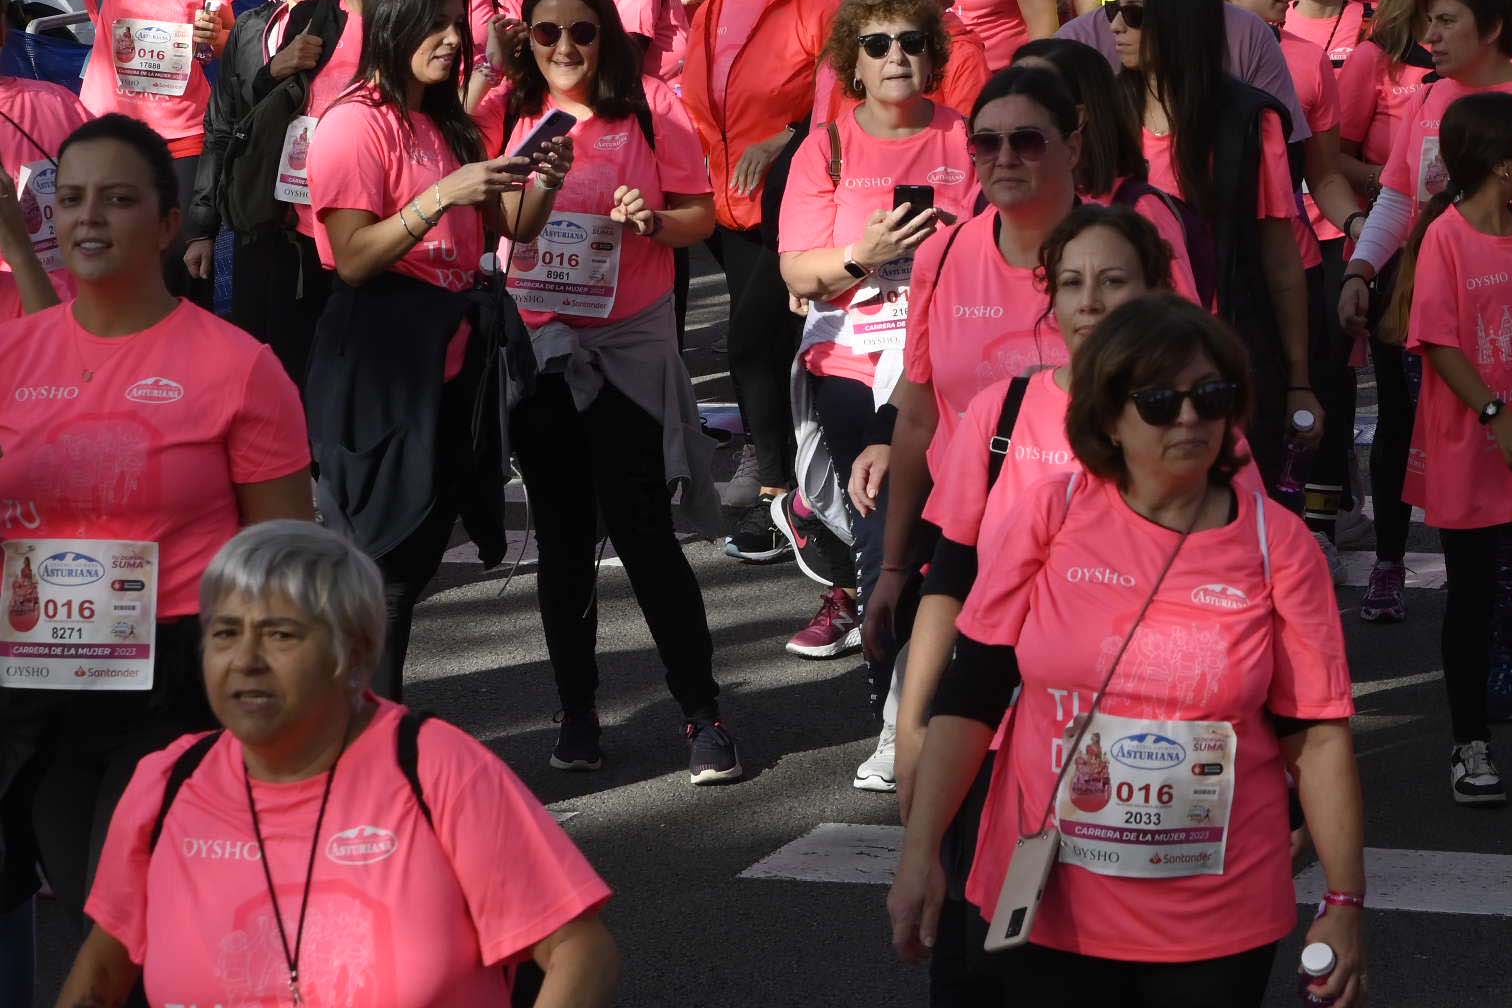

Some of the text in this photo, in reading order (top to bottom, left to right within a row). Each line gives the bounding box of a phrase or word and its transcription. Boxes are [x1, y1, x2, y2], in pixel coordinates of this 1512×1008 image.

[138, 48, 165, 60] 016
[845, 176, 892, 188] OYSHO
[542, 228, 585, 242] ASTURIANA
[541, 250, 580, 268] 016
[546, 271, 570, 281] 8961
[1466, 271, 1509, 291] OYSHO
[514, 280, 543, 289] CARRERA
[543, 282, 555, 291] DE
[572, 298, 608, 311] Santander
[953, 305, 1004, 319] OYSHO
[864, 322, 896, 331] CARRERA
[15, 385, 81, 402] OYSHO
[1015, 446, 1070, 466] OYSHO
[39, 563, 100, 580] ASTURIANA
[112, 559, 145, 570] SUMA
[1066, 566, 1136, 588] OYSHO
[43, 598, 96, 621] 016
[51, 627, 83, 641] 8271
[11, 646, 137, 657] CARRERA DE LA MUJER 2023
[6, 666, 140, 679] OYSHO Santander
[1116, 743, 1180, 762] ASTURIANA
[1192, 742, 1225, 753] SUMA
[1116, 781, 1174, 805] 016
[1124, 810, 1162, 826] 2033
[1074, 826, 1120, 840] CARRERA
[1122, 830, 1138, 841] DE
[1139, 831, 1152, 841] LA
[1154, 832, 1186, 842] MUJER
[182, 837, 263, 862] OYSHO
[1162, 852, 1213, 866] Santander
